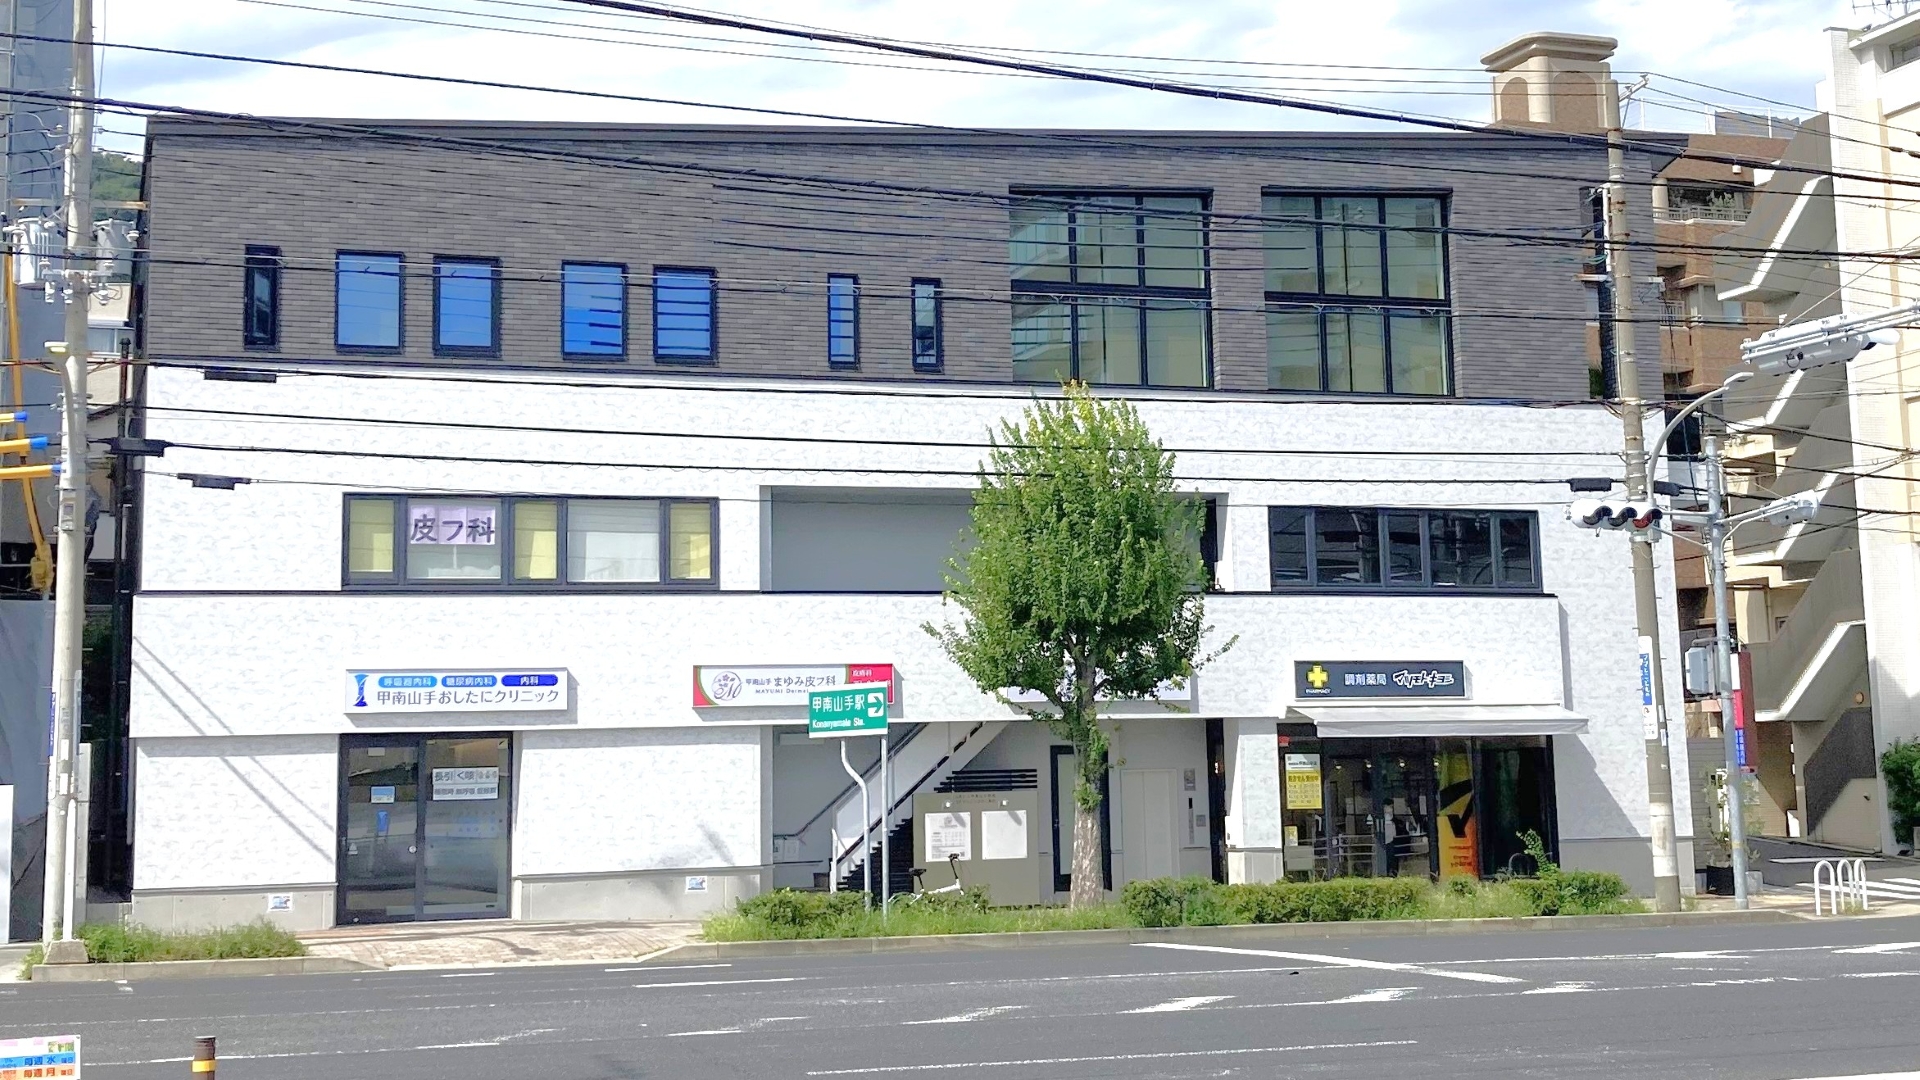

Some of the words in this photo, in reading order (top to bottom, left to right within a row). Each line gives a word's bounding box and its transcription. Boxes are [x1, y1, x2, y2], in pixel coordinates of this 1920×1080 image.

[411, 514, 495, 543] 皮フ科
[383, 677, 432, 687] 呼吸器内科
[446, 676, 493, 686] 糖尿病内科
[520, 676, 539, 685] 内科
[774, 675, 836, 687] まゆみ皮フ科
[1345, 673, 1387, 686] 調剤薬局
[377, 690, 559, 706] 甲南山手おしたにクリニック
[812, 694, 866, 713] 甲南山手駅
